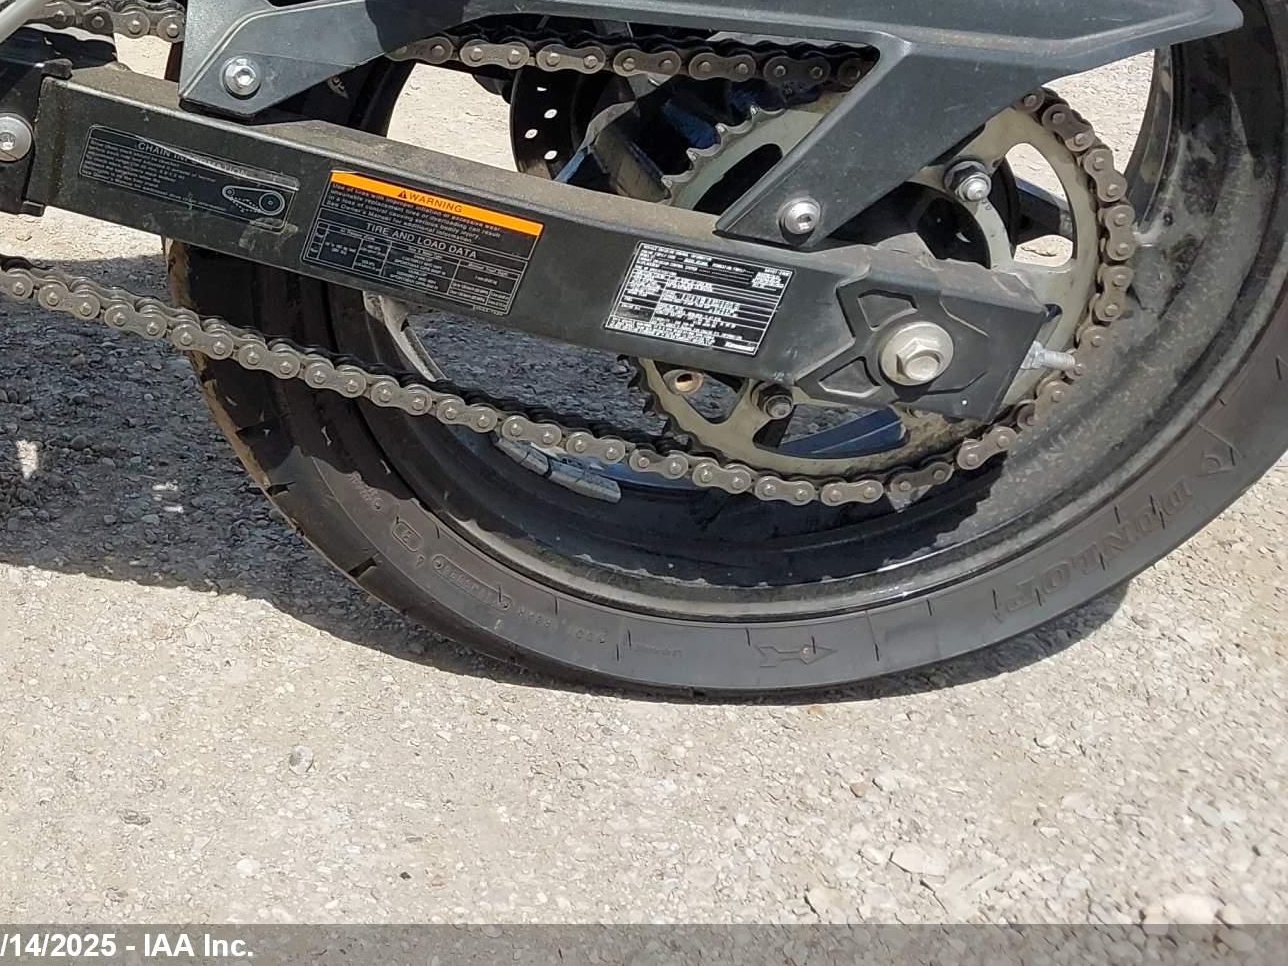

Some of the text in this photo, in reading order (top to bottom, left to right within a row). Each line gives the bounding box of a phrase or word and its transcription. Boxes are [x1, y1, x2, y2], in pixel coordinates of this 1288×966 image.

[138, 142, 171, 158] CHAIN
[409, 193, 462, 213] WARNING
[364, 222, 477, 259] TIRE AND LOAD DATA
[1006, 480, 1194, 614] DUNLOP
